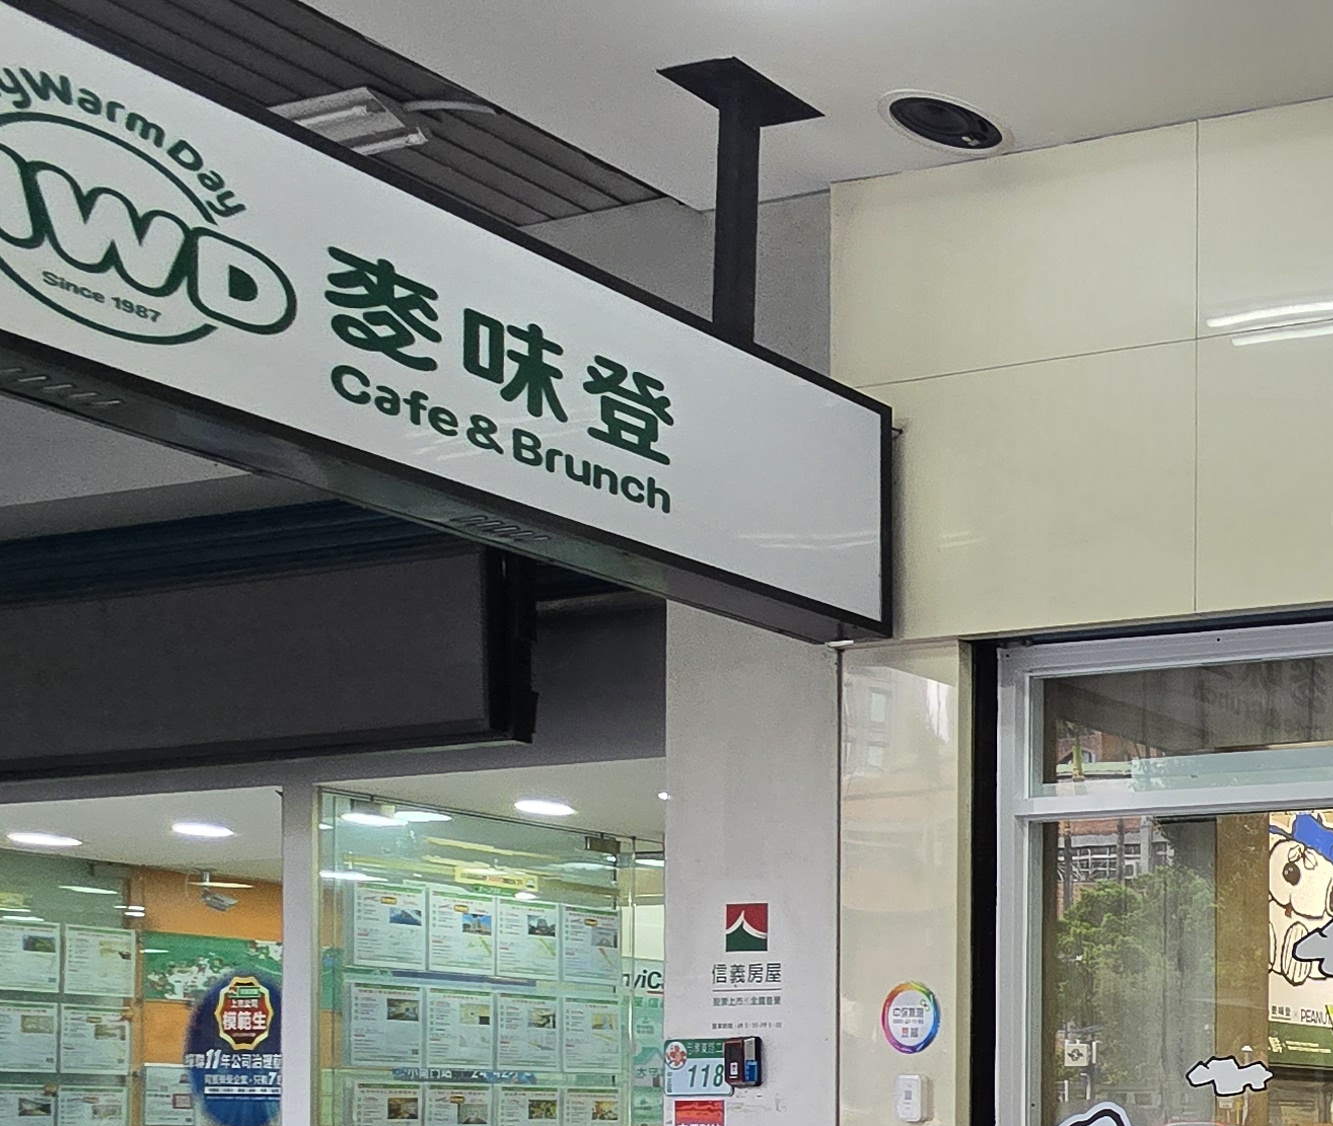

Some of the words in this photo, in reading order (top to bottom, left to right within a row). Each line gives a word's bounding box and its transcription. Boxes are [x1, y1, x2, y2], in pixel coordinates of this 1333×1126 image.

[0, 67, 246, 218] yWarmDay
[42, 271, 105, 303] Since
[111, 296, 161, 322] 1987
[324, 246, 674, 465] 麥味登
[712, 963, 782, 984] 信義房屋
[688, 1064, 724, 1087] 118
